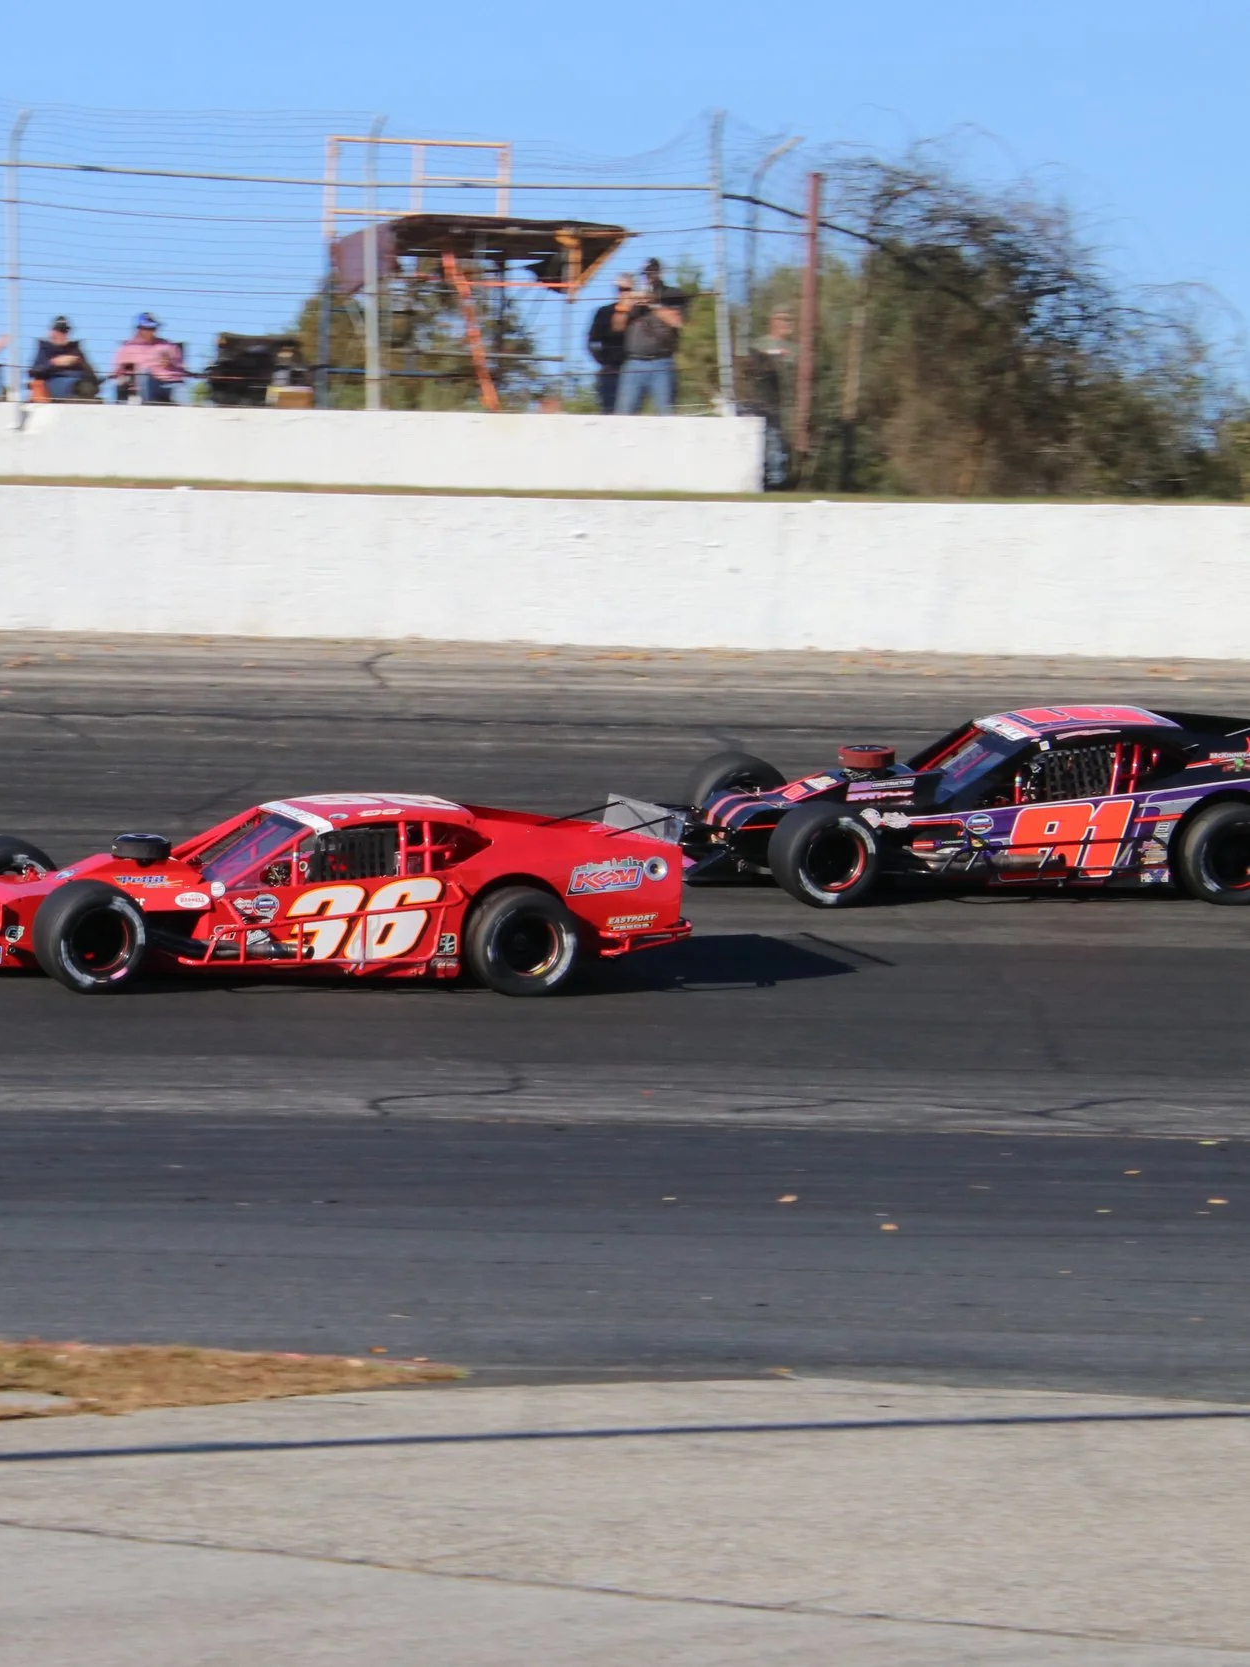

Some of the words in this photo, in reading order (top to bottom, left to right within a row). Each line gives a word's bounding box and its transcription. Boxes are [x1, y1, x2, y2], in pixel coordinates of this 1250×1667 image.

[1000, 800, 1136, 882] 91
[286, 877, 442, 960] 36
[608, 914, 656, 925] EASTPORT
